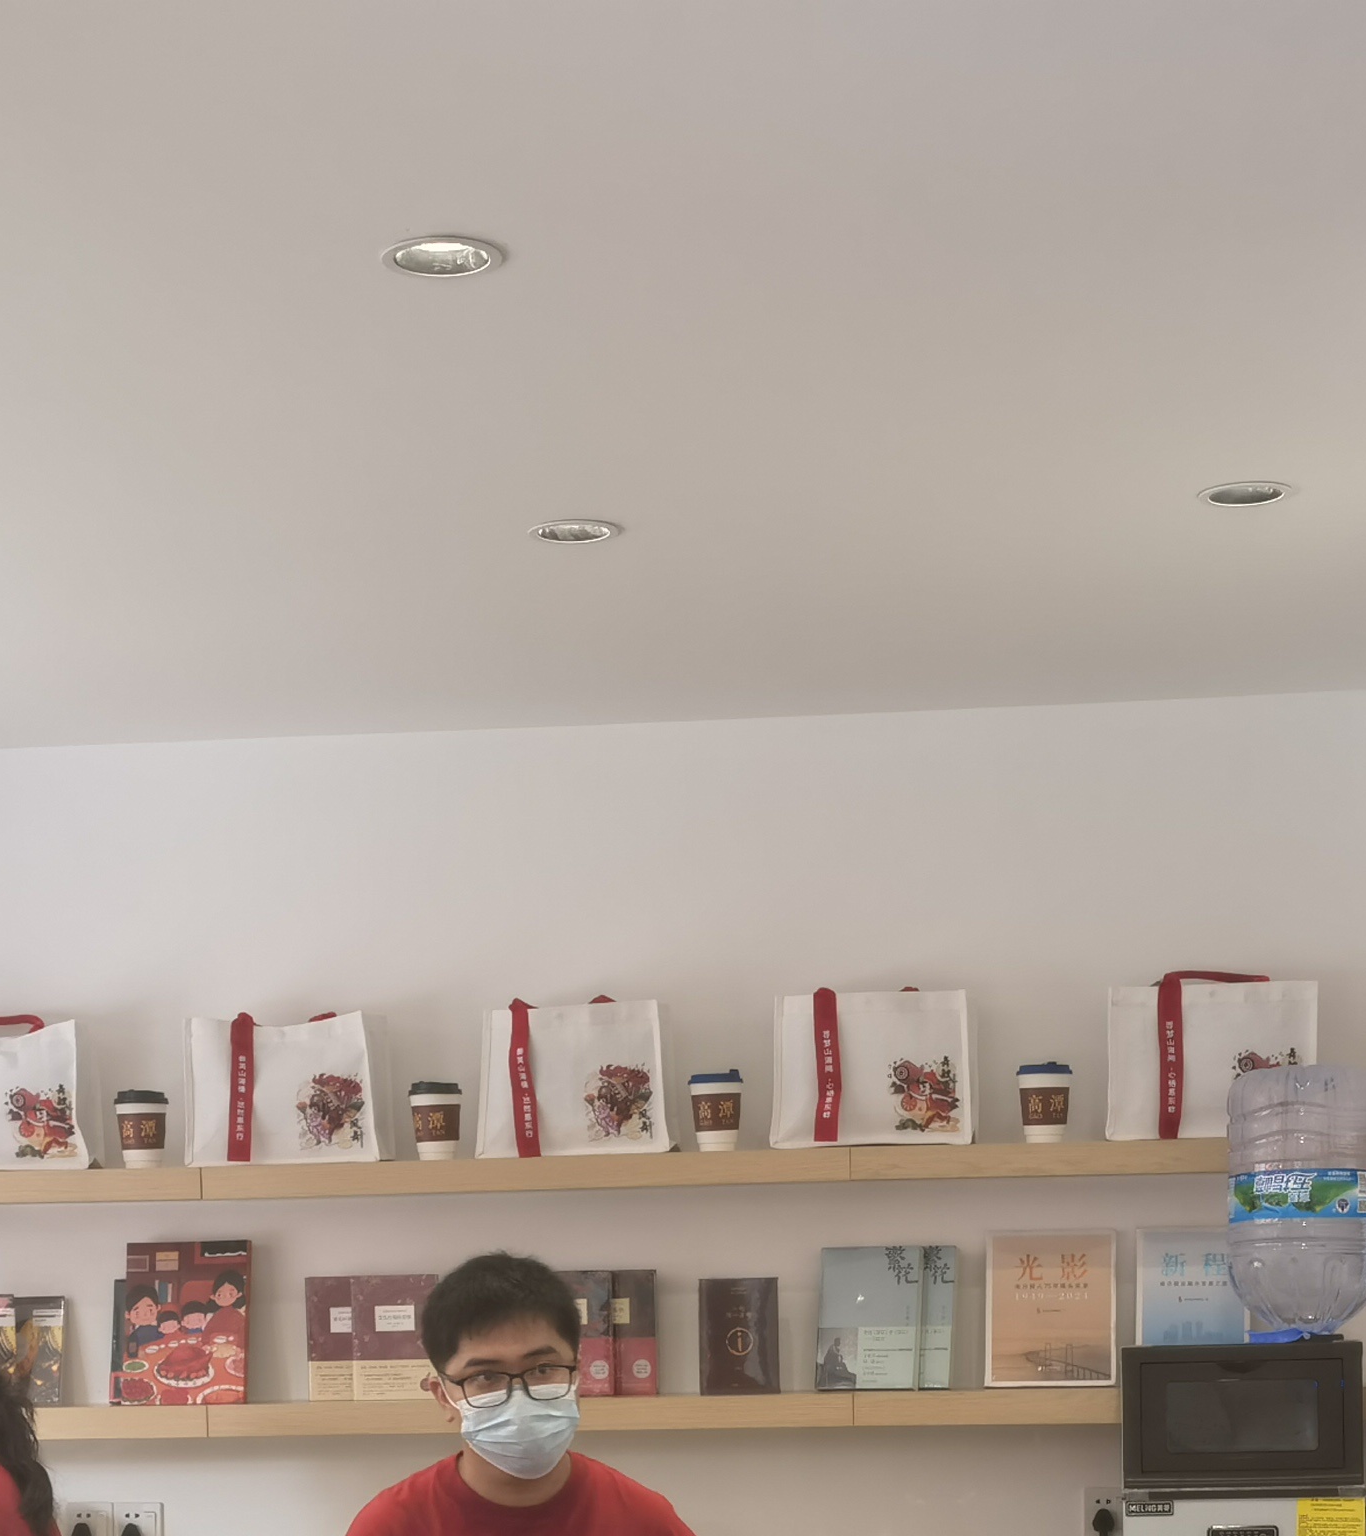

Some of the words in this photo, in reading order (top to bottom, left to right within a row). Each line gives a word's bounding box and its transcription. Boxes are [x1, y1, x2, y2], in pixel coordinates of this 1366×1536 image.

[699, 1099, 734, 1118] 高潭
[121, 1119, 157, 1137] 高潭
[885, 1246, 919, 1284] 繁花
[1015, 1253, 1089, 1281] 光影
